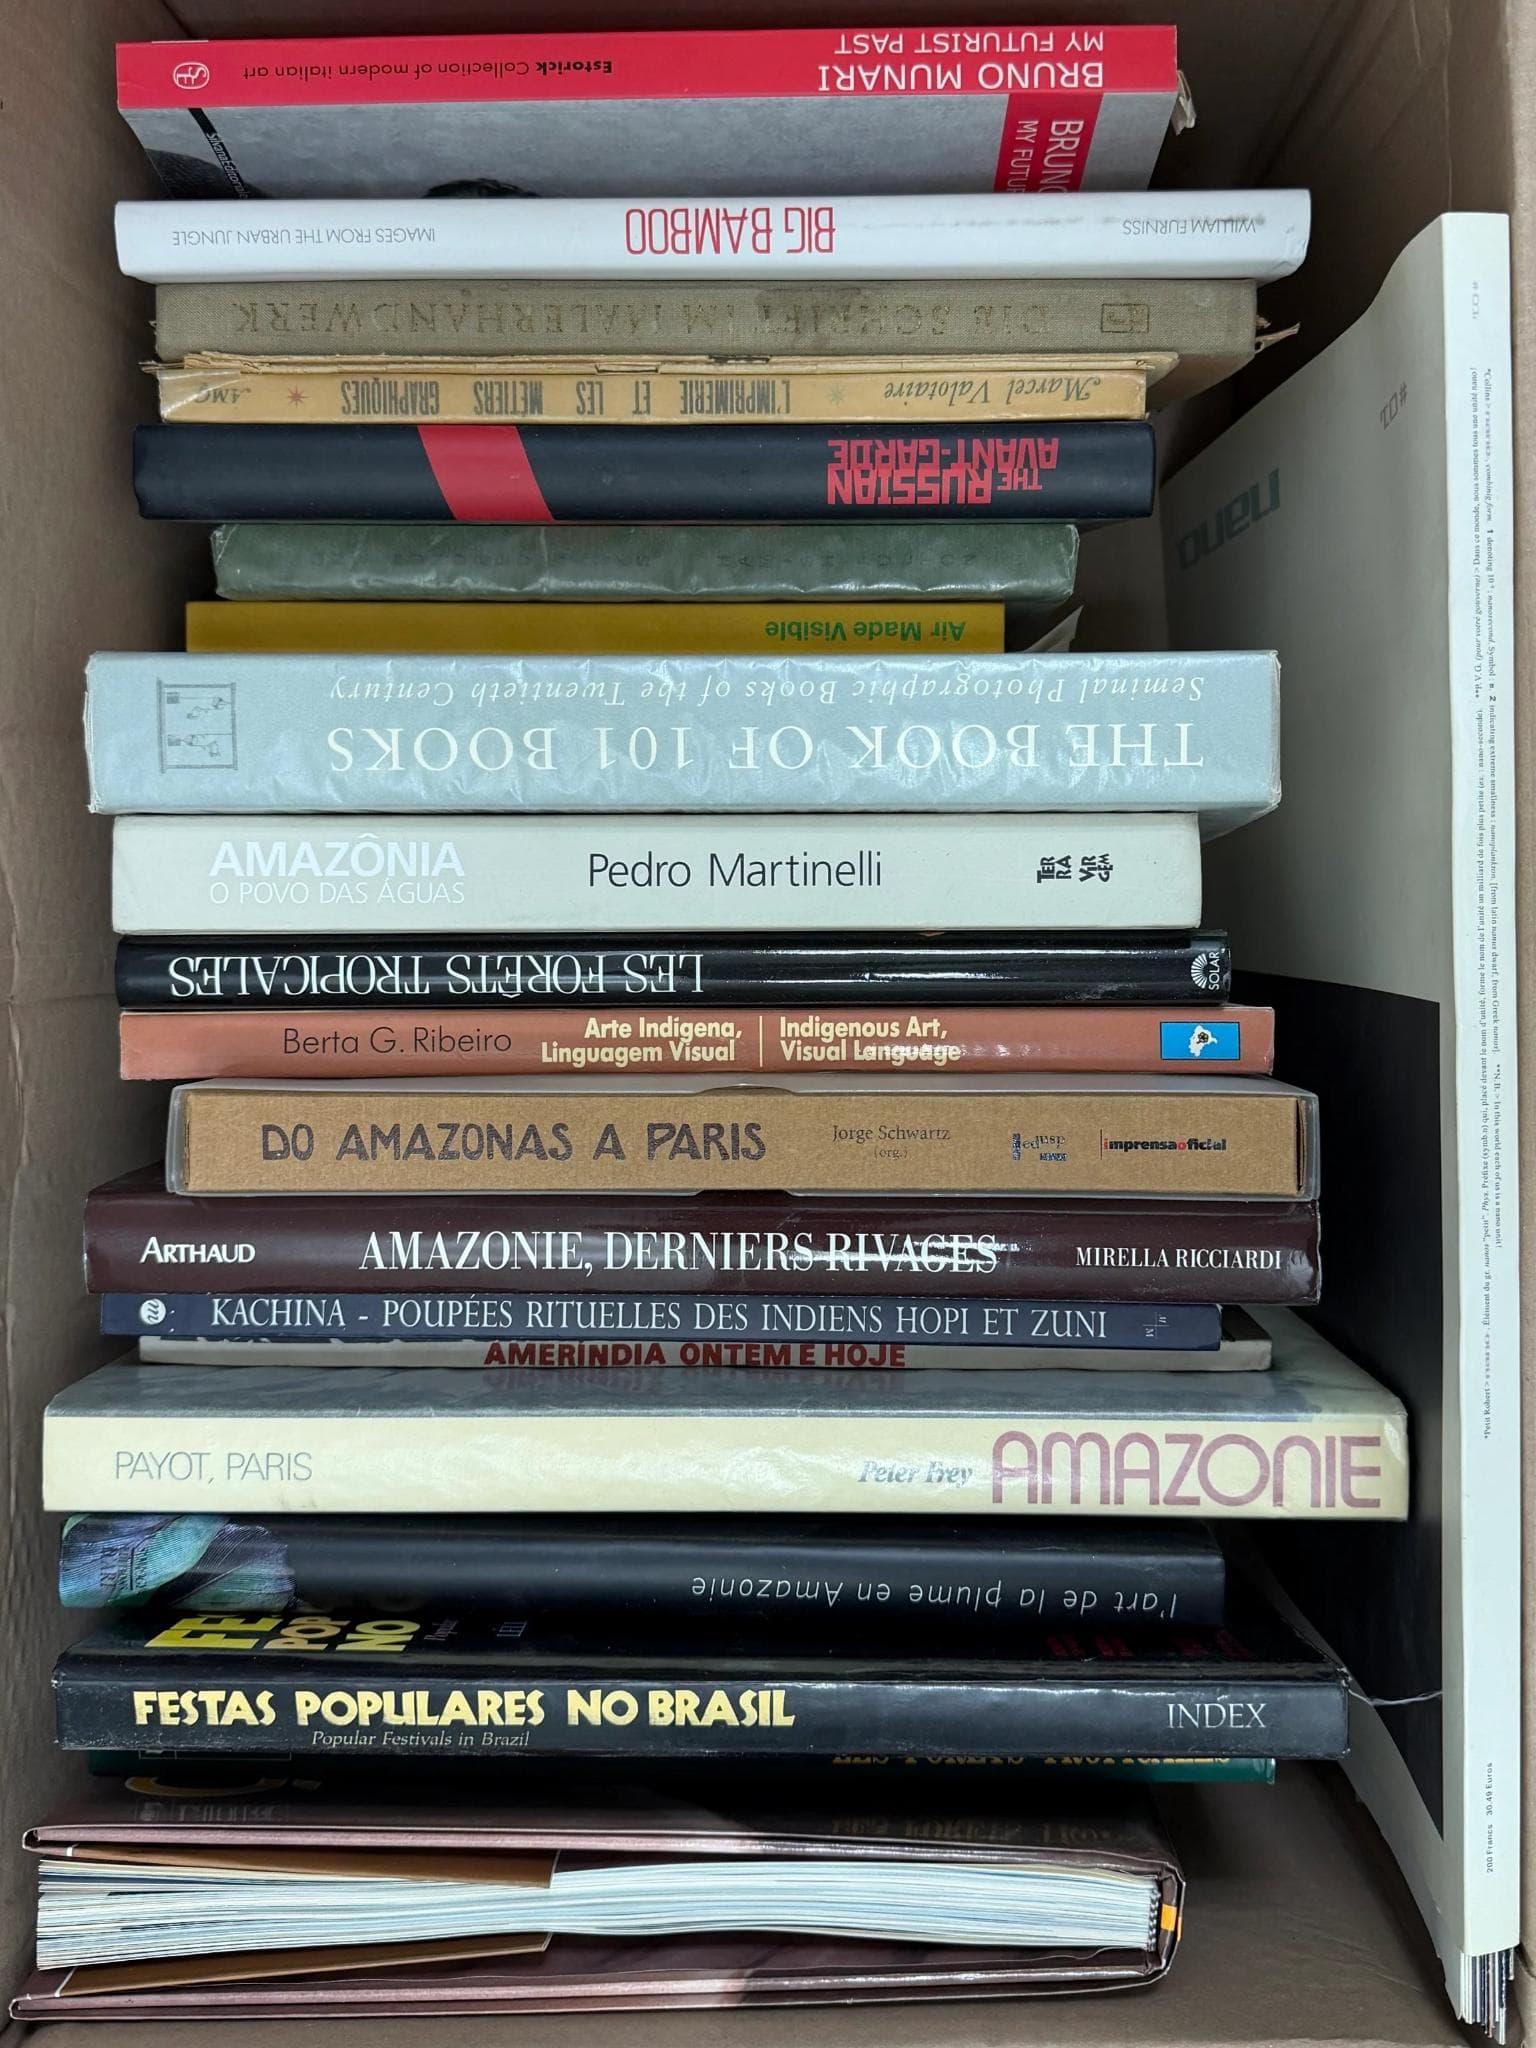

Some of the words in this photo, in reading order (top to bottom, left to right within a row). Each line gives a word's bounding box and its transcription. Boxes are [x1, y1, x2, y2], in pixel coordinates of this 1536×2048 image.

[835, 33, 903, 54] PAST
[915, 32, 1053, 53] FUTURIST
[1066, 31, 1104, 52] MY
[243, 66, 270, 79] art
[275, 64, 342, 81] italian
[346, 63, 409, 80] modern
[416, 62, 437, 76] of
[444, 61, 529, 76] Collection
[536, 60, 612, 74] Estorick
[818, 64, 962, 91] MUNARI
[978, 62, 1103, 88] BRUNO
[1018, 119, 1038, 143] MY
[172, 229, 232, 246] JUNGLE
[236, 229, 292, 245] URBAN
[295, 228, 324, 244] THE
[327, 227, 373, 244] FROM
[376, 227, 435, 243] IMAGES
[625, 208, 772, 255] BAMBOO
[786, 207, 834, 254] BIG
[1123, 220, 1187, 236] FURNISS
[1190, 220, 1257, 236] WILLIAM
[686, 303, 734, 335] IM
[976, 303, 1049, 333] DIE
[340, 376, 441, 416] GRAPHIQUES
[474, 380, 543, 418] MÉTIERS
[576, 380, 604, 415] LES
[632, 380, 652, 415] ET
[680, 380, 791, 415] L'IMPRIMERIE
[884, 378, 990, 405] Valotaire
[1006, 377, 1101, 402] Marcel
[1471, 391, 1479, 413] unité
[827, 437, 1060, 470] AVANT-GARDE
[827, 467, 993, 505] RUSSIAN
[998, 468, 1043, 491] THE
[1176, 467, 1281, 572] nano
[1472, 502, 1482, 532] monde,
[1485, 535, 1495, 572] denoting
[766, 620, 847, 641] Visible
[853, 620, 922, 641] Made
[932, 620, 966, 641] Air
[328, 677, 455, 708] Century
[469, 681, 626, 706] Twentieth
[640, 681, 689, 706] the
[698, 679, 732, 708] of
[744, 677, 837, 704] Books
[853, 673, 1064, 702] Photographic
[1078, 676, 1205, 701] Seminal
[1487, 704, 1497, 743] indicating
[326, 726, 558, 773] BOOKS
[599, 726, 695, 771] 101
[728, 725, 815, 770] OF
[845, 724, 1041, 769] BOOK
[1067, 722, 1205, 768] THE
[1489, 745, 1497, 777] extreme
[1476, 789, 1486, 813] petite
[1490, 779, 1498, 818] smallness
[209, 833, 465, 877] AMAZÔNIA
[588, 852, 691, 888] Pedro
[709, 850, 882, 887] Martinelli
[1477, 859, 1485, 892] milliard
[209, 881, 230, 904] O
[238, 881, 310, 904] POVO
[320, 881, 370, 904] DAS
[377, 878, 465, 904] ÁGUAS
[168, 955, 430, 997] TROPICALES
[446, 954, 605, 1000] FORÊTS
[624, 953, 704, 994] LES
[1208, 951, 1220, 990] SOLAR
[1478, 970, 1486, 995] forme
[1492, 999, 1500, 1024] Greek
[283, 1028, 360, 1055] Berta
[369, 1027, 404, 1054] G.
[413, 1026, 513, 1053] Ribeiro
[583, 1018, 632, 1038] Arte
[638, 1016, 742, 1043] Indígena,
[779, 1016, 900, 1041] Indigenous
[906, 1016, 949, 1040] Art,
[541, 1042, 665, 1068] Linguagem
[669, 1041, 735, 1062] Visual
[779, 1040, 848, 1061] Visual
[853, 1040, 962, 1068] Language
[261, 1123, 315, 1161] DO
[336, 1122, 574, 1161] AMAZONAS
[593, 1123, 626, 1161] A
[646, 1121, 767, 1161] PARIS
[832, 1124, 874, 1146] Jorge
[877, 1123, 951, 1142] Schwartz
[1102, 1137, 1228, 1152] imprensaoficial
[1494, 1127, 1502, 1150] world
[874, 1146, 908, 1161] (org.)
[358, 1230, 594, 1277] AMAZONIE,
[604, 1231, 813, 1271] DERNIERS
[825, 1232, 999, 1273] RIVAGES
[1075, 1245, 1169, 1269] MIRELLA
[1175, 1247, 1282, 1271] RICCIARDI
[210, 1298, 346, 1327] KACHINA
[382, 1294, 513, 1329] POUPÉES
[526, 1300, 681, 1330] RITUELLES
[694, 1302, 749, 1331] DES
[761, 1303, 884, 1334] INDIENS
[896, 1305, 969, 1336] HOPI
[981, 1306, 1019, 1336] ET
[1031, 1309, 1107, 1339] ZUNI
[680, 1342, 795, 1367] ONTEM
[799, 1343, 817, 1367] E
[824, 1343, 906, 1368] HOJE
[1483, 1387, 1491, 1415] Robert
[114, 1452, 215, 1484] PAYOT,
[226, 1452, 313, 1481] PARIS
[858, 1460, 916, 1484] Peter
[926, 1461, 973, 1490] Frey
[991, 1430, 1381, 1509] AMAZONIE
[691, 1575, 845, 1607] Amazonie
[857, 1583, 892, 1601] en
[909, 1578, 1002, 1610] plume
[1019, 1586, 1045, 1611] la
[1063, 1588, 1098, 1613] de
[1114, 1591, 1178, 1620] l'art
[336, 1618, 422, 1652] NO
[133, 1690, 276, 1726] FESTAS
[296, 1690, 545, 1726] POPULARES
[567, 1690, 639, 1726] NO
[649, 1689, 796, 1728] BRASIL
[1166, 1702, 1267, 1729] INDEX
[311, 1730, 376, 1749] Popular
[382, 1731, 453, 1748] Festivals
[458, 1732, 477, 1747] in
[481, 1731, 531, 1748] Brazil
[1486, 1763, 1494, 1790] Euros
[1486, 1823, 1494, 1856] Francs
[1486, 1857, 1494, 1874] 200
